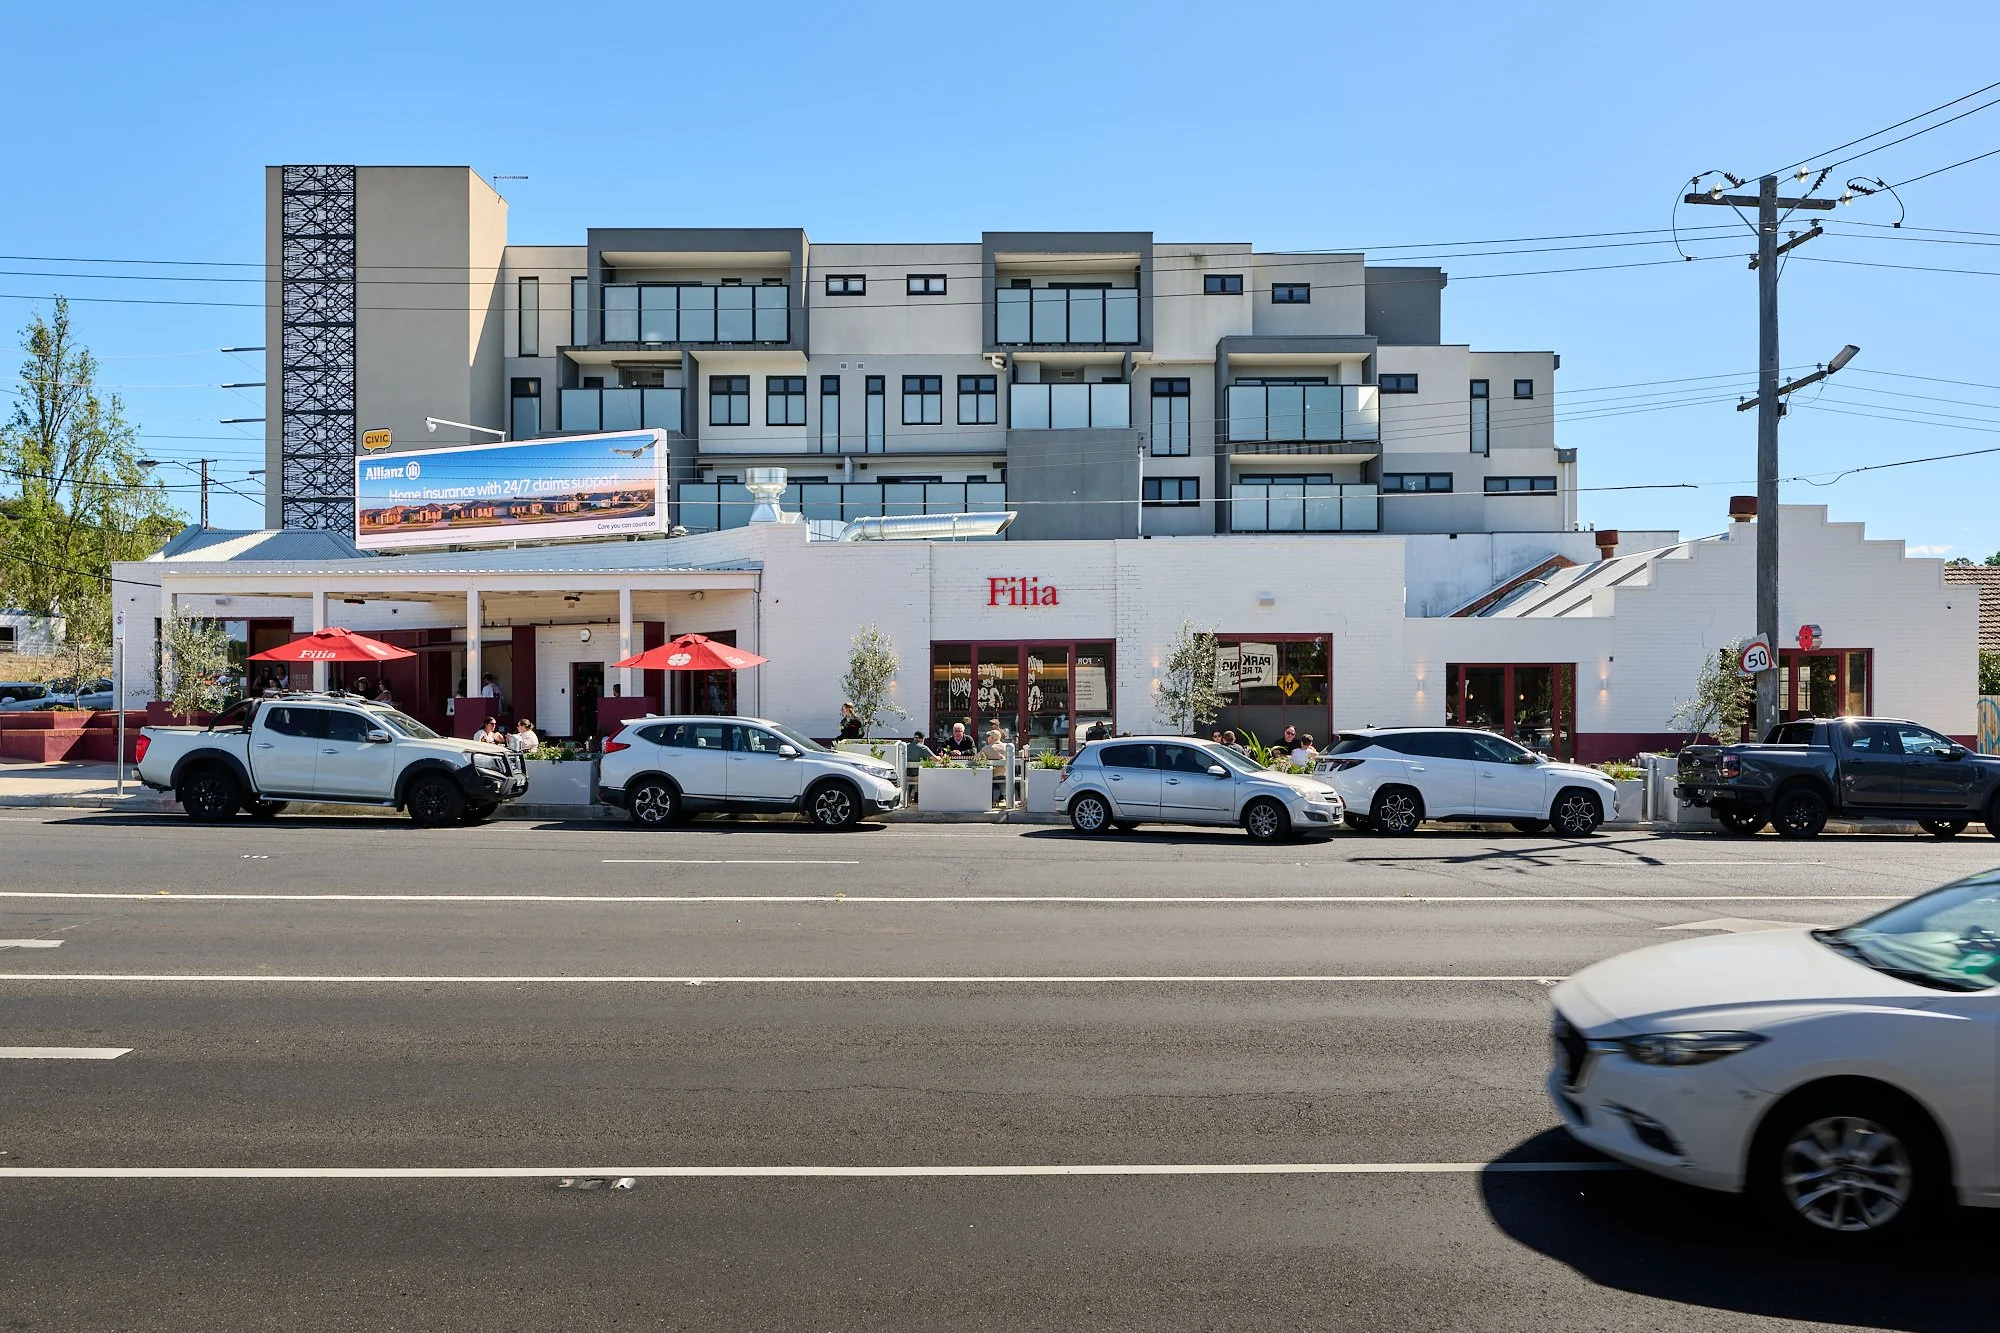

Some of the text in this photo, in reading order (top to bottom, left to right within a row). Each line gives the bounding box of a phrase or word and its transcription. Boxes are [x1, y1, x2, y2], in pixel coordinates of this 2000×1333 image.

[365, 434, 389, 444] CIVIC
[365, 466, 404, 480] Allianz
[390, 474, 619, 502] Home insurance with 24/7 claims support
[986, 576, 1060, 606] Filia
[298, 650, 337, 659] Filia
[1748, 650, 1767, 668] 50
